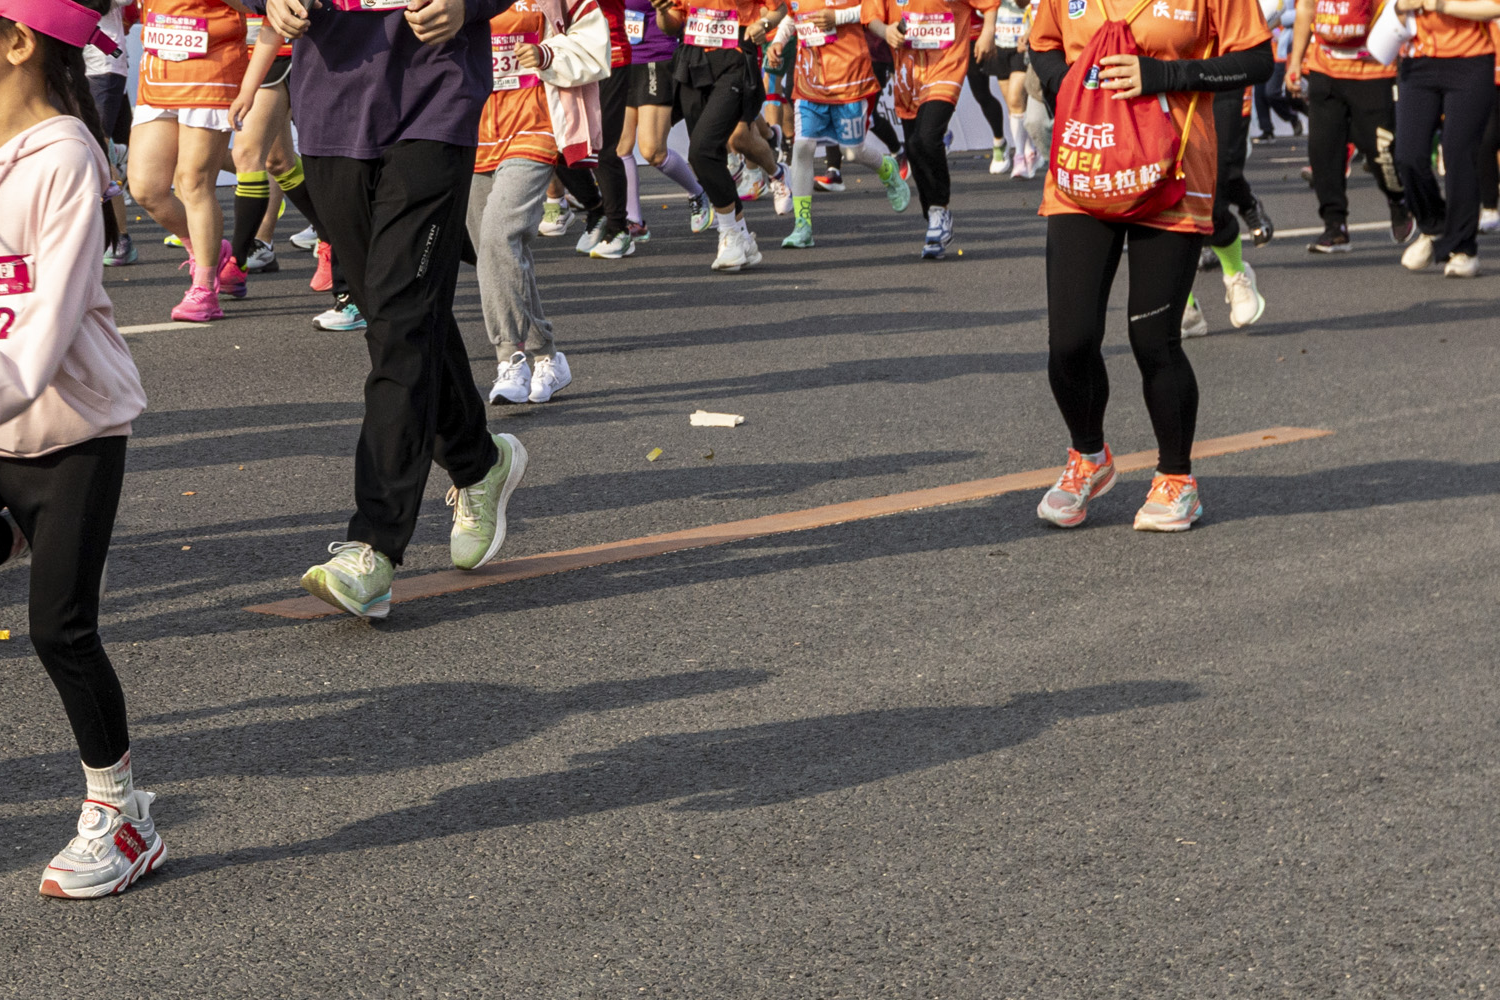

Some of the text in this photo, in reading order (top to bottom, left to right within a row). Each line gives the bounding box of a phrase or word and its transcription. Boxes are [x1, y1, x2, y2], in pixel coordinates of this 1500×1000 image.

[689, 21, 734, 34] M01339
[148, 31, 203, 48] M02282
[841, 116, 862, 139] 30
[1057, 163, 1161, 193] 保定马拉松
